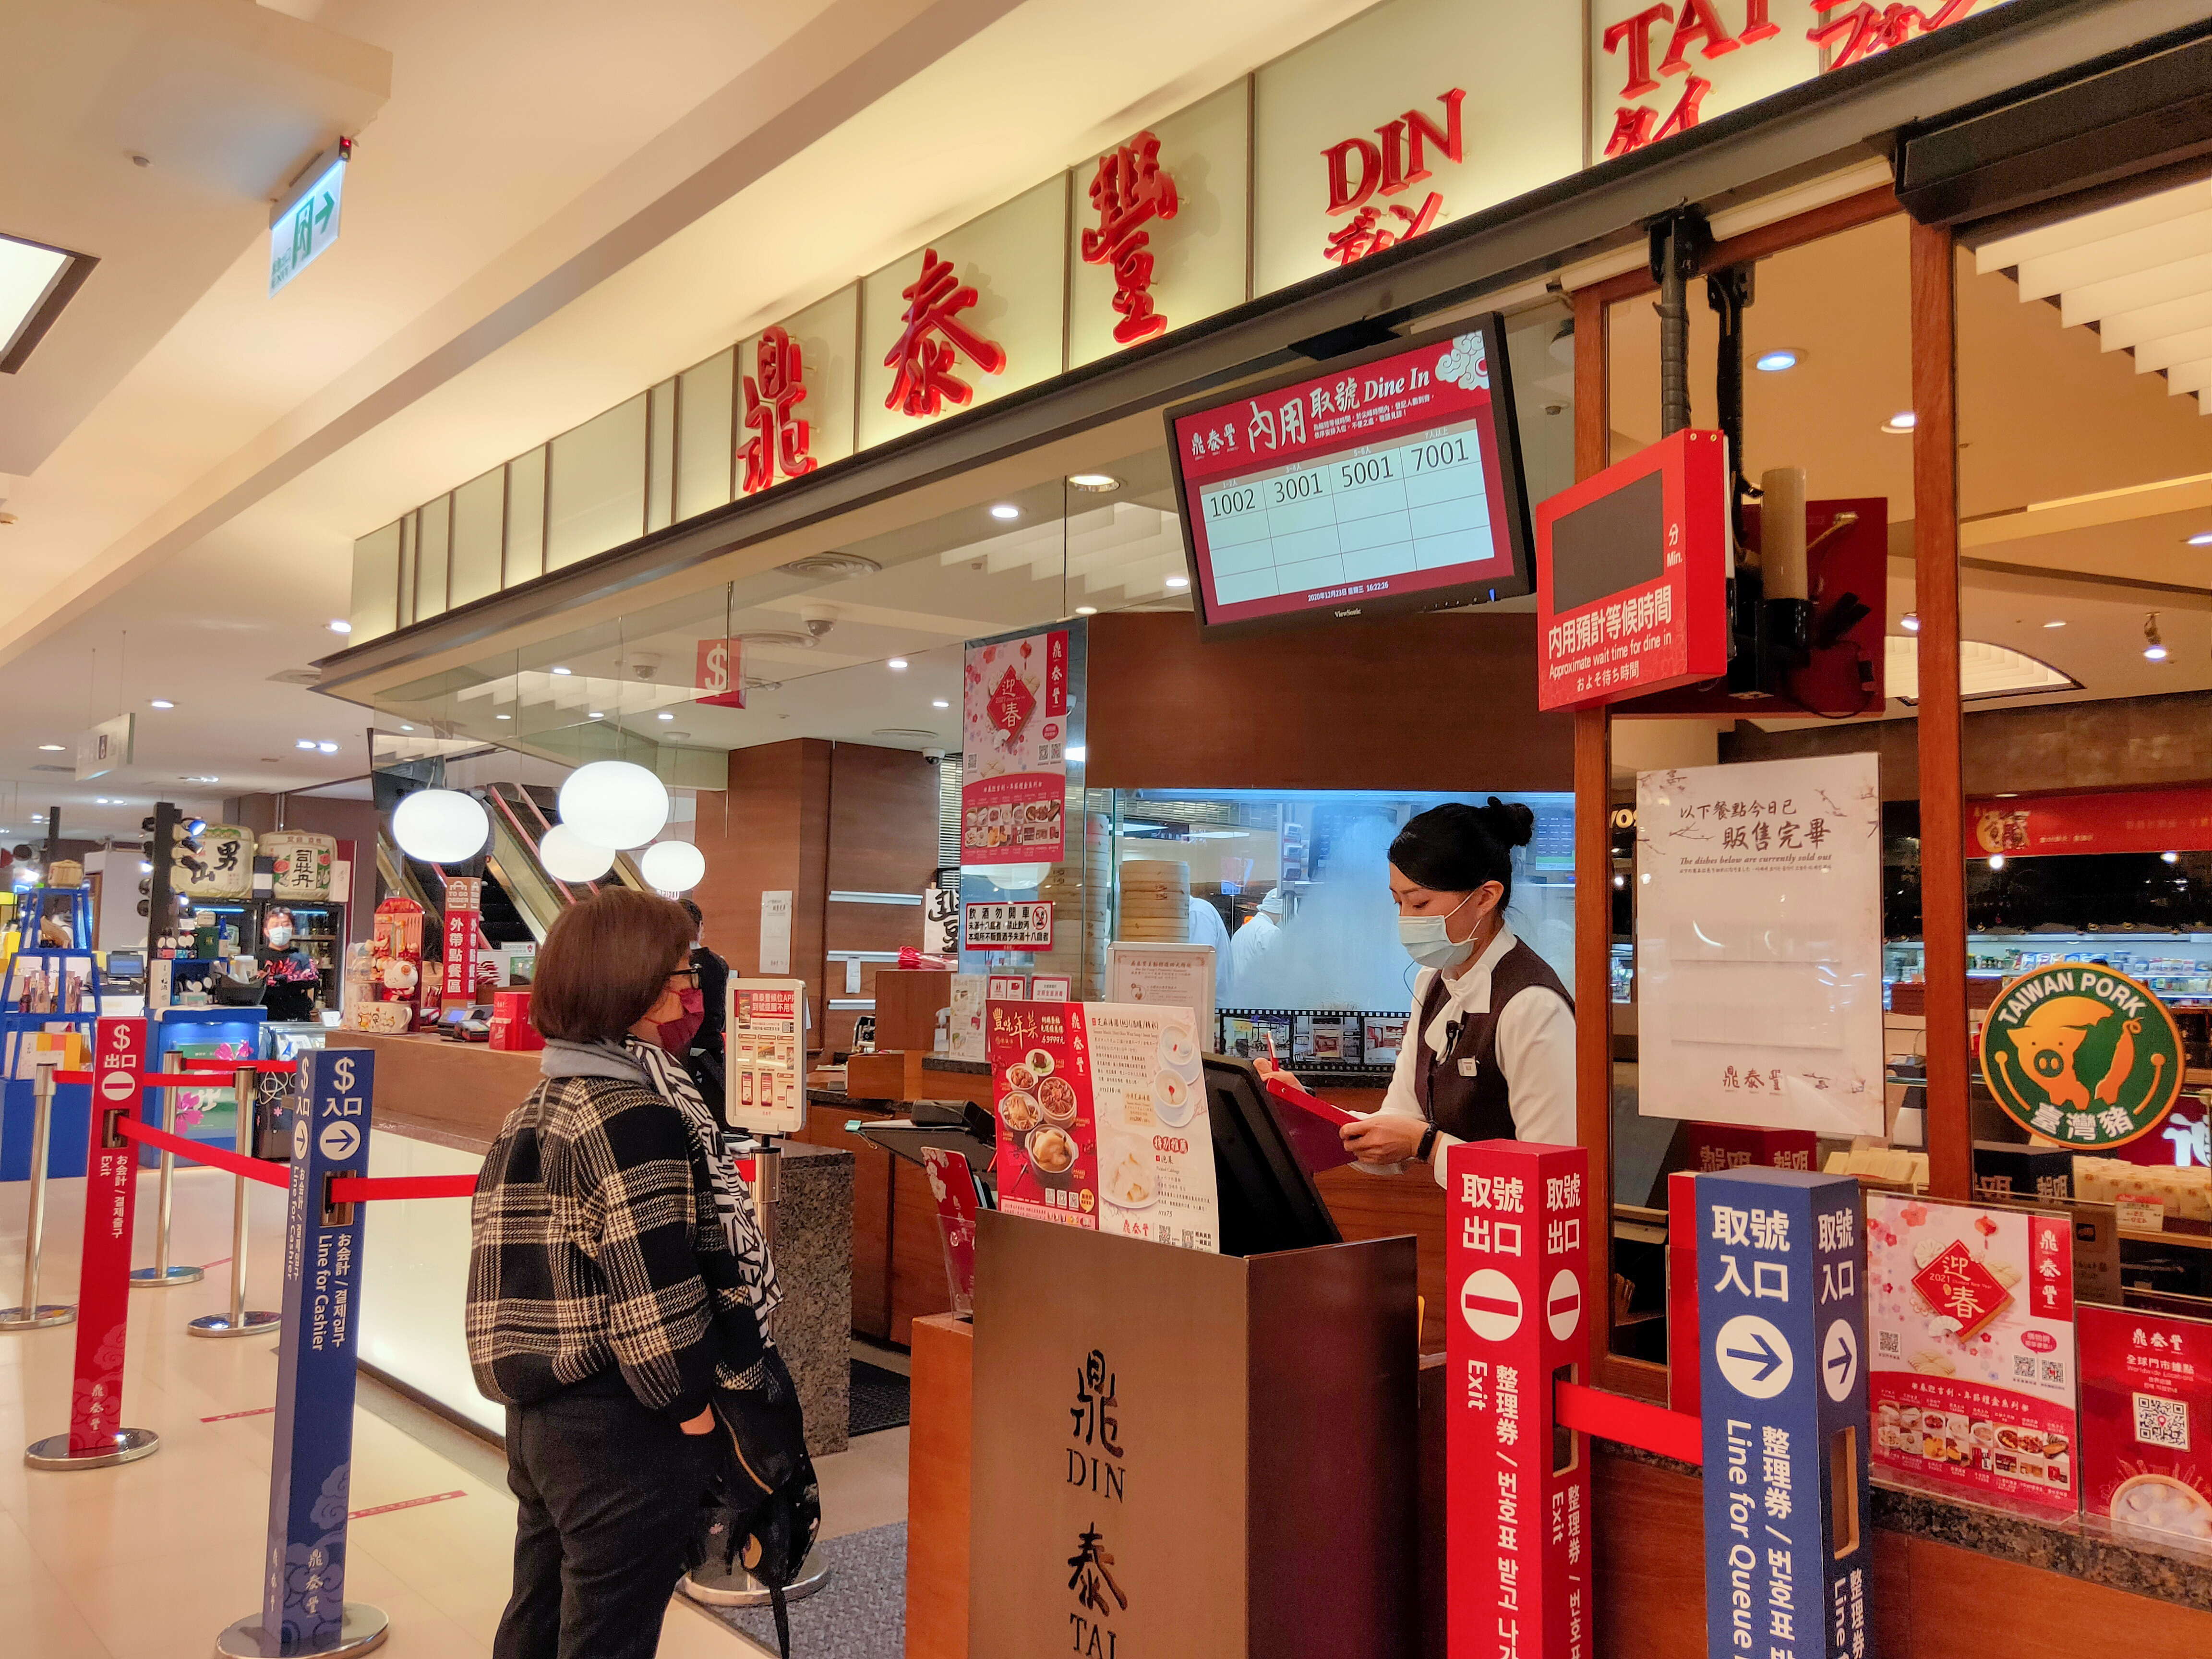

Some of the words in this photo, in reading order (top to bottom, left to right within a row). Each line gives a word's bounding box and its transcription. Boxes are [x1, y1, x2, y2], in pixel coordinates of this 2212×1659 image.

[1320, 88, 1466, 216] DIN
[736, 130, 1178, 494] 鼎泰豐
[1363, 377, 1405, 403] Dine
[1409, 368, 1430, 390] In
[1191, 423, 1236, 456] 鼎泰豐
[1411, 438, 1469, 472] 7001
[1274, 472, 1322, 503] 3001
[1341, 456, 1394, 488] 5001
[1210, 489, 1255, 517] 1002
[1668, 523, 1679, 546] 分
[1667, 551, 1683, 567] Min.
[1334, 608, 1361, 618] ViewSonic
[1051, 640, 1062, 704] 鼎泰豐
[1549, 655, 1591, 680] Approximate
[1593, 648, 1609, 665] wait
[1611, 643, 1628, 660] time
[1630, 638, 1641, 655] for
[1643, 632, 1661, 651] dine
[1663, 628, 1671, 645] in
[1577, 660, 1639, 692] およそ待ち時間
[1680, 799, 1797, 820] 以下餐點今日已
[1723, 818, 1831, 851] 販售完畢
[1695, 856, 1717, 865] dishes
[1719, 854, 1742, 864] below
[1758, 854, 1795, 866] currently
[1798, 853, 1815, 861] sold
[969, 906, 1030, 919] 飲酒勿開車
[447, 917, 464, 993] 外帶點餐區
[1998, 972, 2074, 1024] TAIWAN
[2080, 973, 2147, 1018] PORK
[113, 1024, 131, 1051] $
[1071, 1012, 1084, 1072] 鼎泰豐
[104, 1054, 136, 1068] 出口
[301, 1057, 309, 1094] $
[334, 1057, 355, 1094] $
[1723, 1066, 1783, 1091] 鼎泰豐
[296, 1097, 310, 1117] 入口
[322, 1097, 361, 1117] 入口
[100, 1155, 113, 1177] Exit
[1462, 1174, 1524, 1214] 取號
[1547, 1172, 1580, 1212] 取號
[1123, 1219, 1149, 1237] 鼎泰豐
[1463, 1216, 1521, 1257] 出口
[1548, 1218, 1579, 1255] 出口
[1712, 1205, 1790, 1252] 取號
[1818, 1208, 1854, 1251] 取號
[318, 1235, 333, 1267] Line
[336, 1233, 352, 1276] お会計
[2040, 1230, 2061, 1305] 鼎泰豐
[316, 1269, 331, 1292] for
[1714, 1254, 1790, 1302] 入口
[1821, 1260, 1854, 1305] 入口
[1929, 1273, 1950, 1282] 2021
[312, 1295, 329, 1351] Cashier
[332, 1289, 348, 1347] 결제입구
[2132, 1328, 2183, 1351] 鼎泰豐
[1070, 1349, 1124, 1458] 鼎
[1468, 1359, 1488, 1411] Exit
[1496, 1364, 1519, 1445] 整理券
[1727, 1419, 1752, 1484] Line
[1762, 1426, 1792, 1519] 整理券
[1066, 1448, 1126, 1503] DIN
[1498, 1471, 1518, 1551] 번호표
[1552, 1491, 1564, 1545] Exit
[1568, 1484, 1580, 1565] 整理券
[1730, 1492, 1755, 1538] for
[305, 1549, 323, 1615] 鼎泰豐
[1068, 1521, 1128, 1616] 泰
[1498, 1556, 1519, 1611] 받고
[1729, 1544, 1756, 1648] Queue
[1768, 1548, 1795, 1641] 번호표
[1835, 1577, 1846, 1647] Line
[1070, 1613, 1117, 1659] TAI
